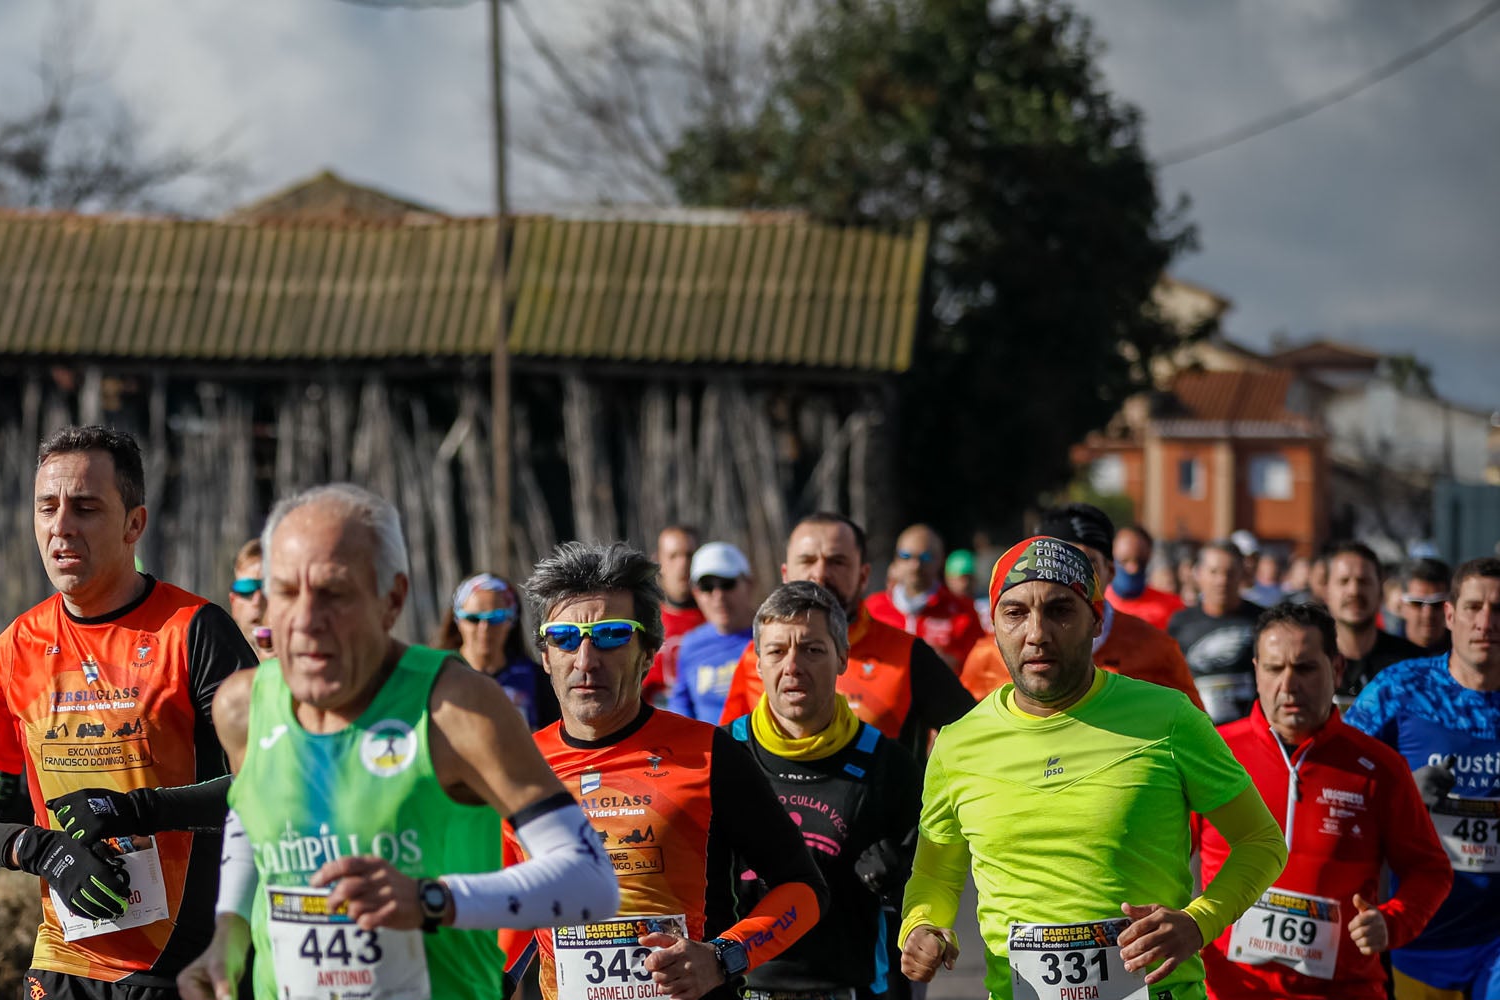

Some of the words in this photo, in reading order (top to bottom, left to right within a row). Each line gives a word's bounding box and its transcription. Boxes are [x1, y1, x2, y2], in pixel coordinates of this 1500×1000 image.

[1036, 558, 1087, 584] ARMADAS
[1037, 569, 1068, 584] 2019
[113, 701, 135, 710] Plano
[45, 756, 89, 767] FRANCISCO
[1044, 767, 1064, 779] ipso
[789, 795, 829, 815] CULLAR
[589, 808, 617, 819] Vidrio
[619, 807, 645, 817] Plano
[585, 923, 634, 932] CARRERA
[586, 930, 634, 939] POPULAR
[1042, 926, 1091, 935] CARRERA
[1262, 913, 1318, 946] 169
[585, 938, 612, 946] Secaderos
[1043, 933, 1091, 942] POPULAR
[300, 928, 383, 967] 443
[583, 948, 653, 985] 343
[1040, 949, 1109, 986] 331
[317, 969, 373, 986] ANTONIO
[587, 985, 634, 1000] CARMELO
[1060, 986, 1099, 1000] PIVERA
